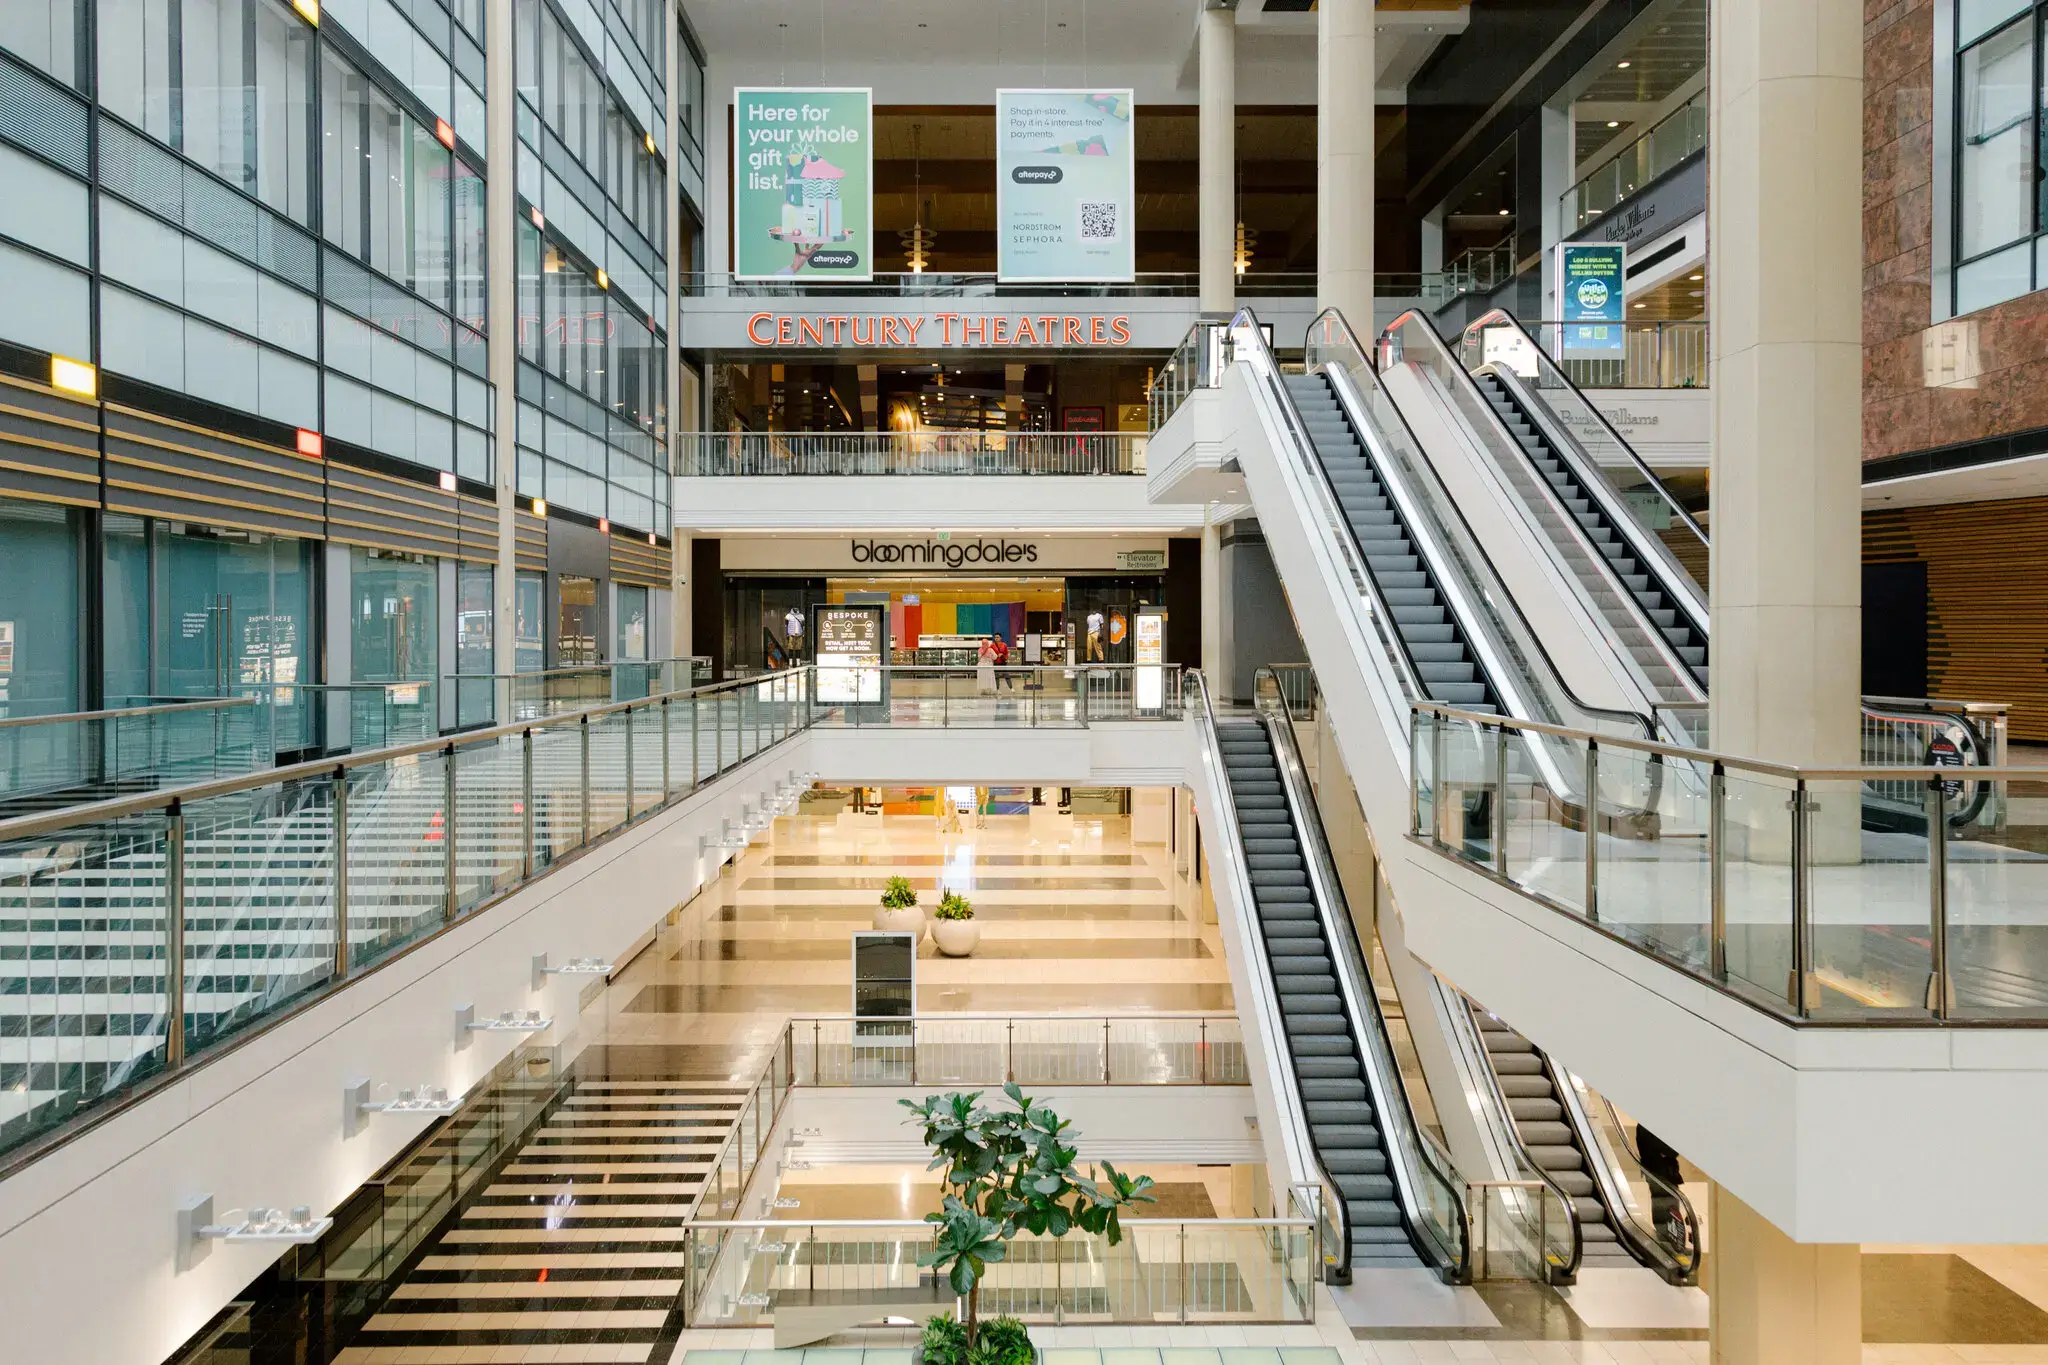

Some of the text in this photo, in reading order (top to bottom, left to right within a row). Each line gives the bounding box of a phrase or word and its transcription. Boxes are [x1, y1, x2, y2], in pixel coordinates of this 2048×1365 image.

[748, 104, 830, 121] Here for
[1010, 107, 1033, 117] Shop
[1010, 119, 1026, 128] Pay
[748, 126, 859, 146] your whole
[1010, 131, 1055, 139] payments.
[748, 149, 783, 169] gift
[1018, 170, 1048, 180] afterpay
[748, 172, 784, 190] list.
[1013, 223, 1062, 231] NORDSTROM
[1013, 235, 1063, 243] SEPHORA
[813, 255, 844, 264] afterpay
[747, 312, 1132, 345] CENTURY THEATRES
[852, 539, 1038, 568] bloomingdale's
[1126, 554, 1157, 562] Elevator
[827, 612, 869, 620] BESPOKE
